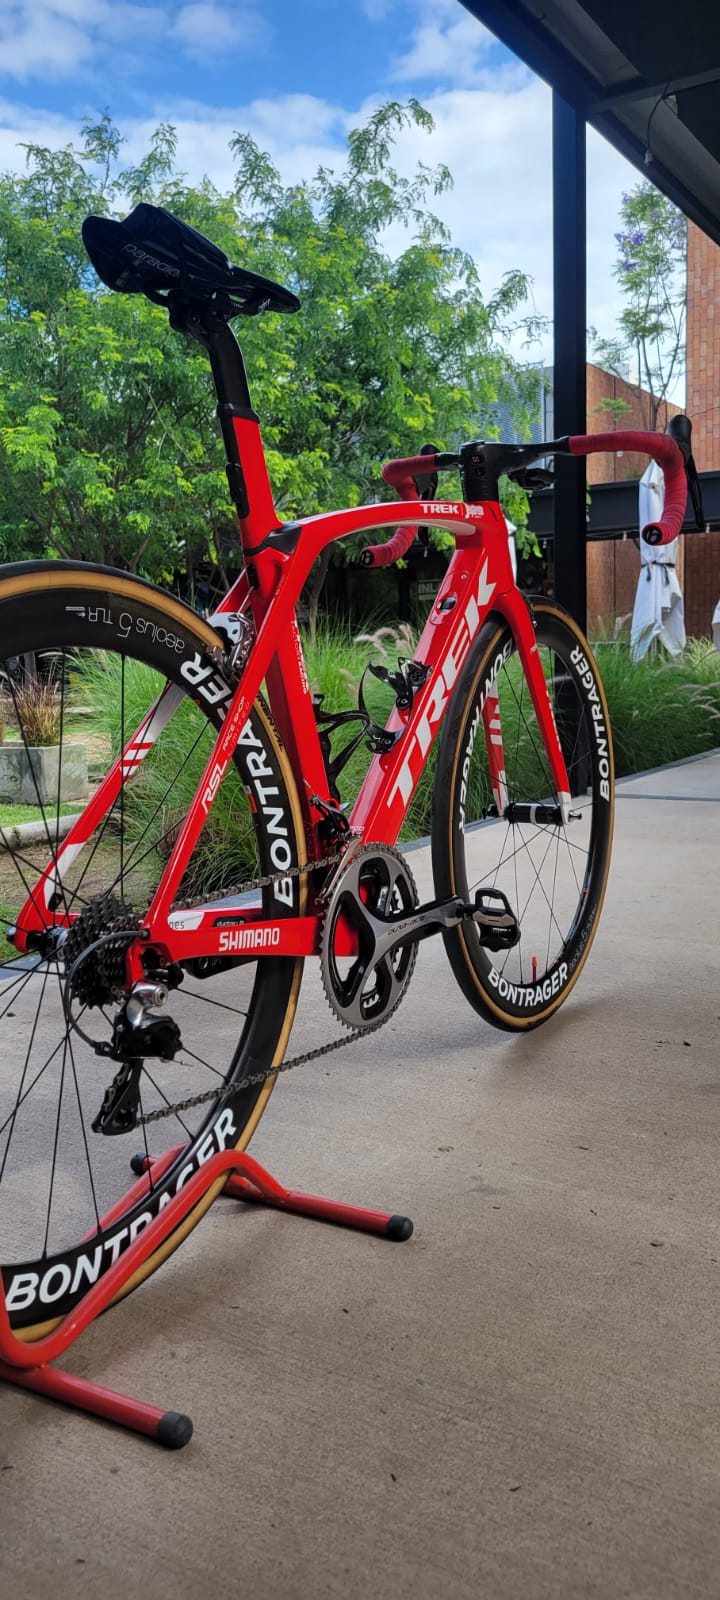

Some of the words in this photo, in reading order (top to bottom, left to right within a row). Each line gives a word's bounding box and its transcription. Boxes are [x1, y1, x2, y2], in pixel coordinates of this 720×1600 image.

[420, 503, 459, 514] TREK
[116, 612, 133, 638] 5
[135, 617, 185, 654] aeolus
[387, 557, 497, 807] TREK
[569, 645, 611, 801] BONTRAGER
[201, 759, 228, 814] RSL
[222, 723, 236, 751] RACE
[233, 695, 245, 723] SHOP
[181, 652, 294, 908] BONTRAER
[218, 927, 281, 952] SHIMANO
[488, 962, 568, 1007] BONTRAGER
